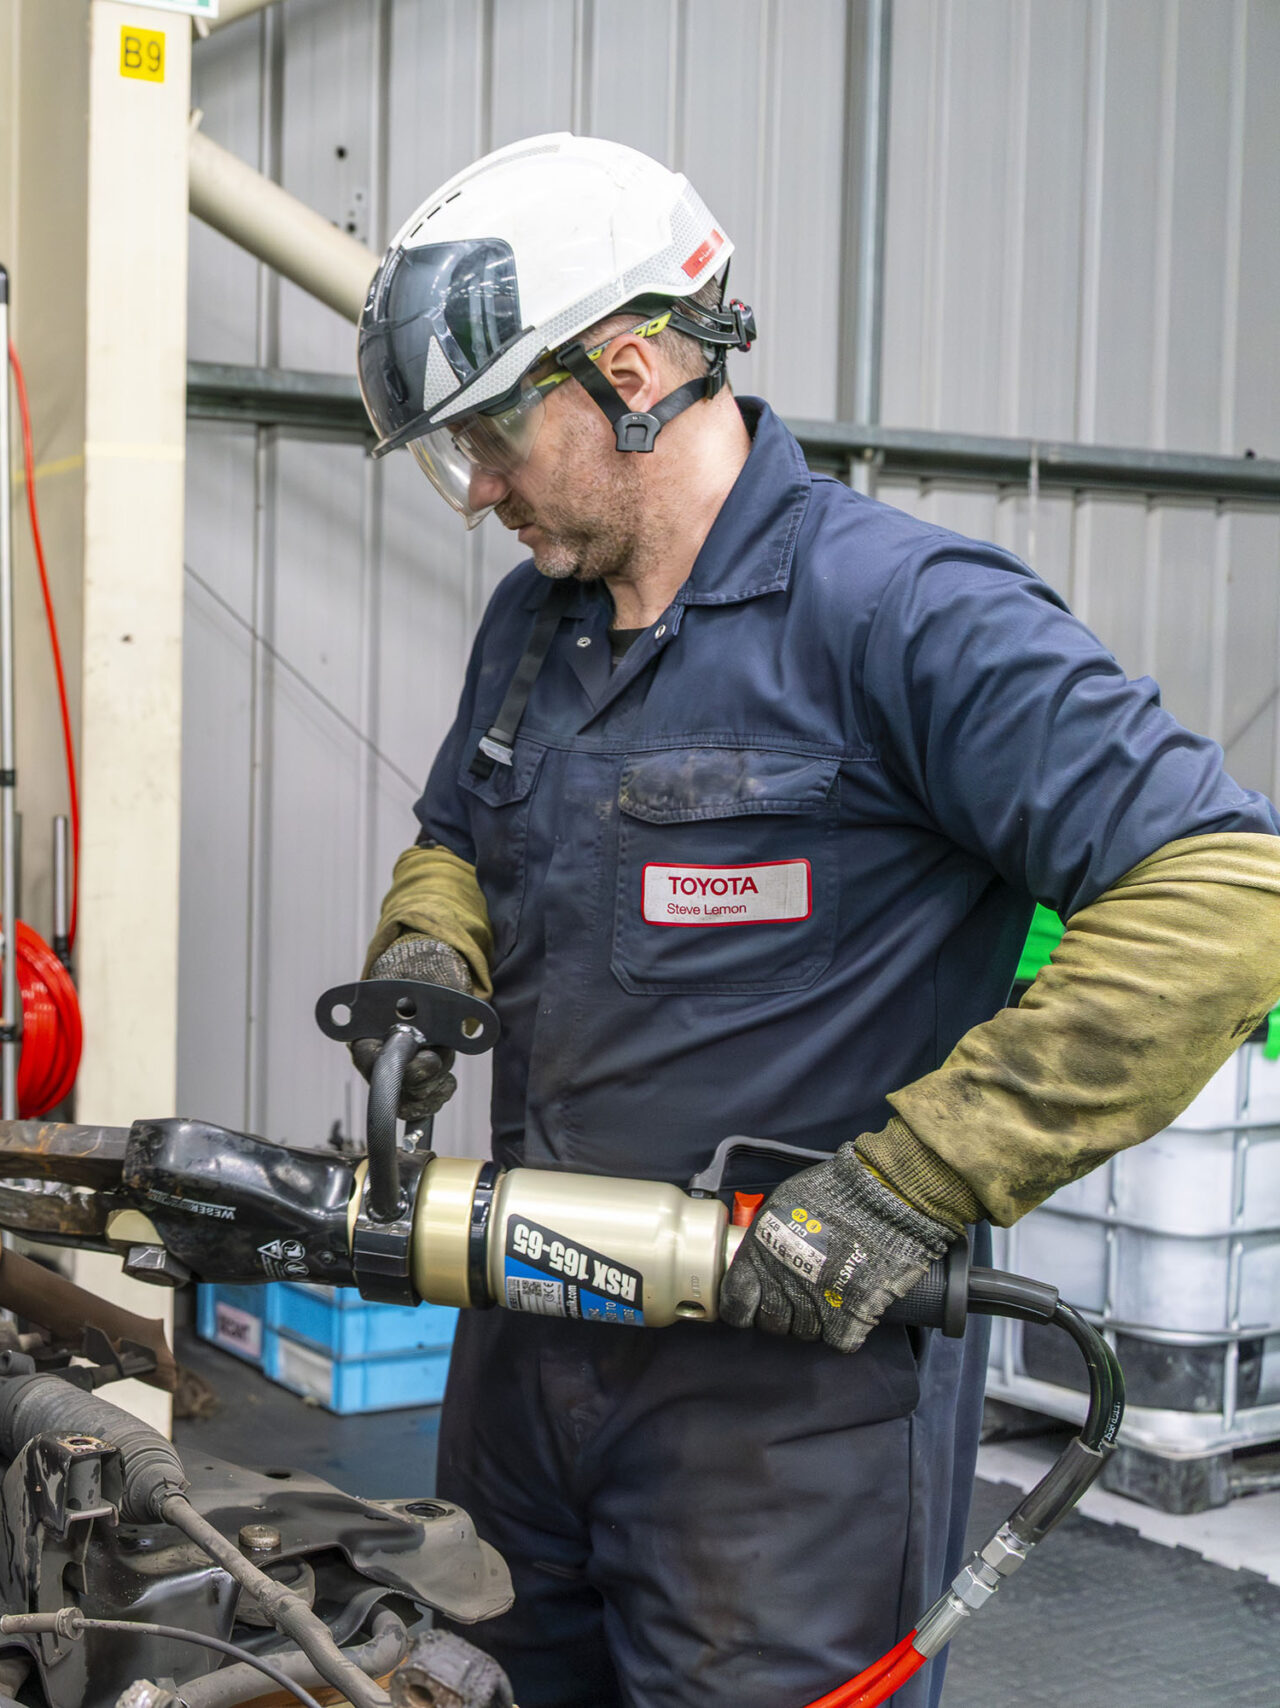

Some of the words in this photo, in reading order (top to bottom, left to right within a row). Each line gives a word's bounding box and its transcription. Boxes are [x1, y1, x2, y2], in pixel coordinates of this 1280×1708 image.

[125, 36, 161, 73] B9
[668, 876, 759, 896] TOYOTA
[667, 903, 700, 915] Steve
[704, 903, 747, 915] Lemon
[787, 1220, 808, 1238] CUT
[513, 1223, 589, 1281] 165-65
[832, 1247, 868, 1292] TILSATEC
[592, 1260, 637, 1302] RSX
